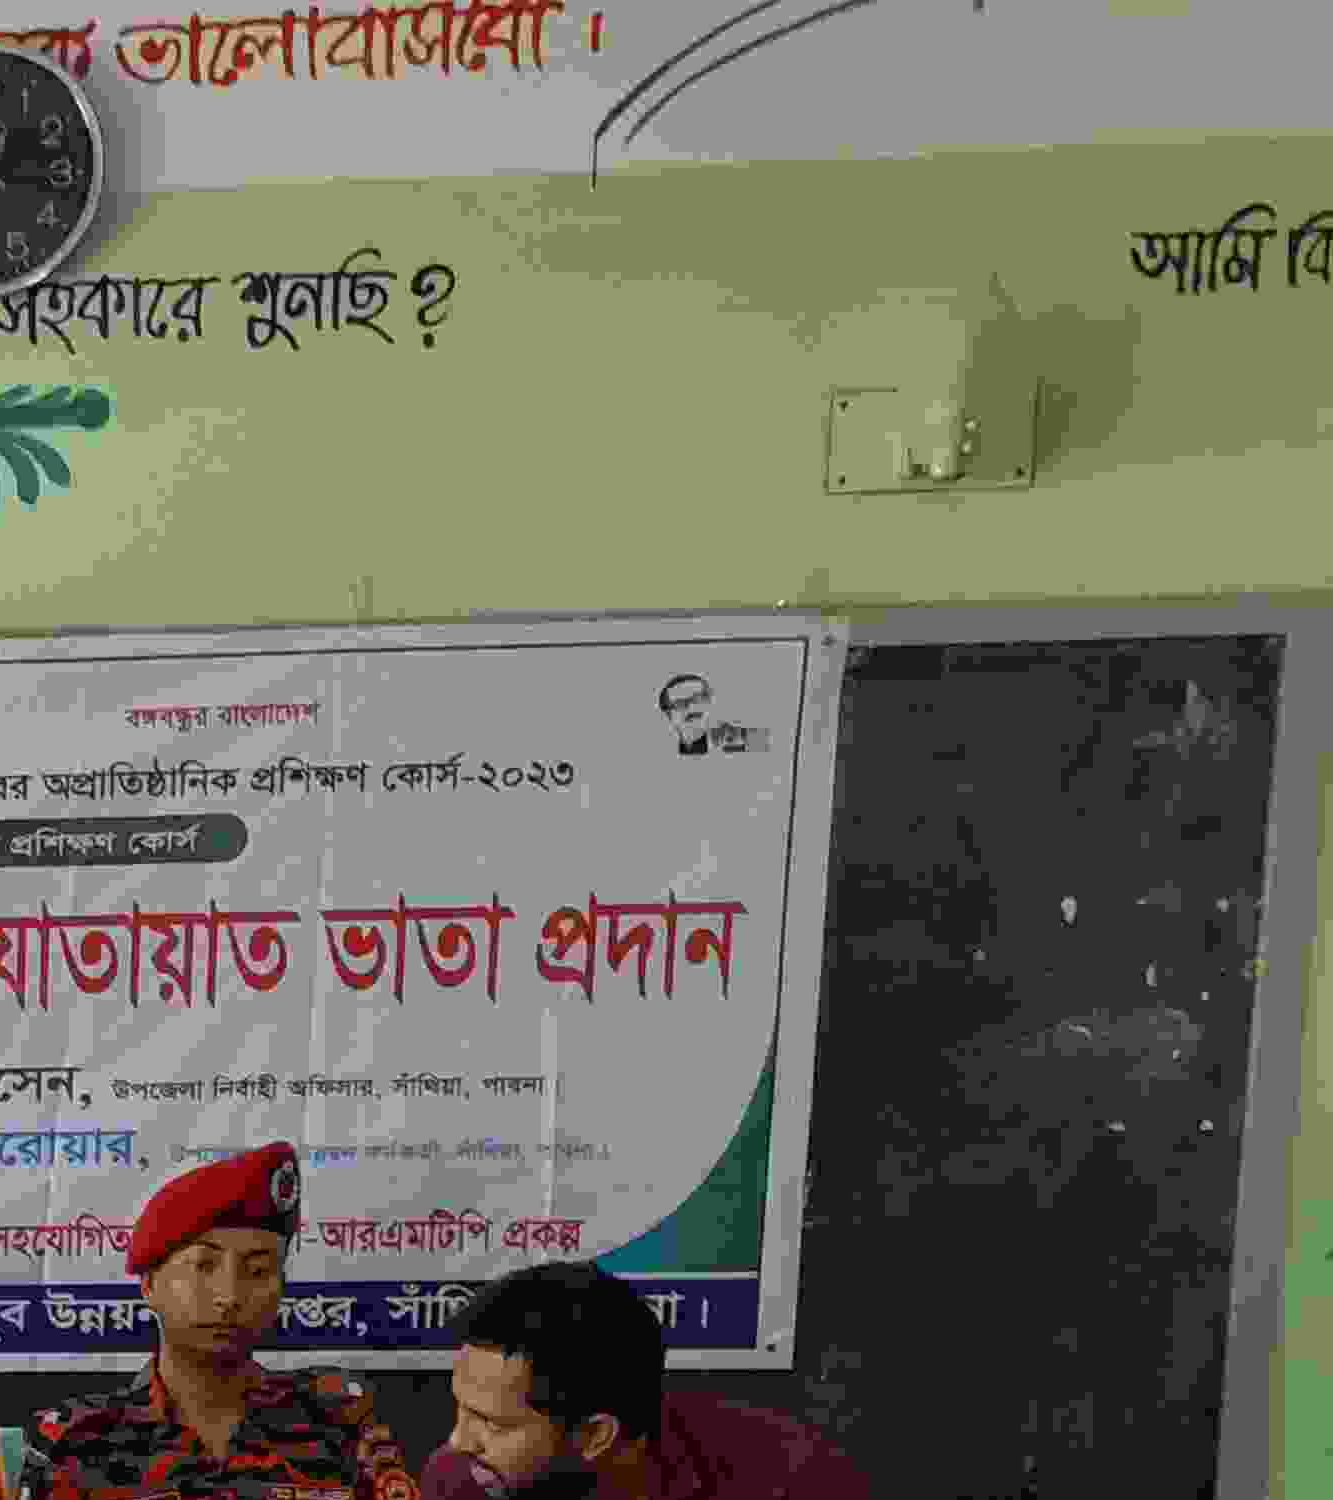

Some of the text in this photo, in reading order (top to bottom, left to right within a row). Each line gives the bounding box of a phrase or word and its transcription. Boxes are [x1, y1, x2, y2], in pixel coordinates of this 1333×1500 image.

[113, 0, 565, 85] ভালোবাসবো
[40, 115, 64, 144] 2
[45, 155, 73, 185] 3
[37, 202, 61, 228] 4
[6, 232, 29, 267] 5
[1126, 200, 1278, 296] আমি
[232, 247, 397, 352] শুনছি
[410, 264, 455, 349] ?
[42, 757, 239, 801] অপ্রাতিষ্ঠানিক
[250, 754, 370, 799] প্রশিক্ষণ
[381, 751, 576, 794] কোর্স-২০২৩
[6, 825, 118, 859] প্রশিক্ষণ
[128, 823, 202, 855] কোর্স
[319, 890, 518, 1007] ভাতা
[535, 888, 750, 1006] প্রদান
[109, 1076, 204, 1103] উপজেলা
[213, 1072, 278, 1103] নির্বাহী
[500, 1214, 587, 1258] প্রকল্প
[276, 1294, 368, 1336] দপ্তর,
